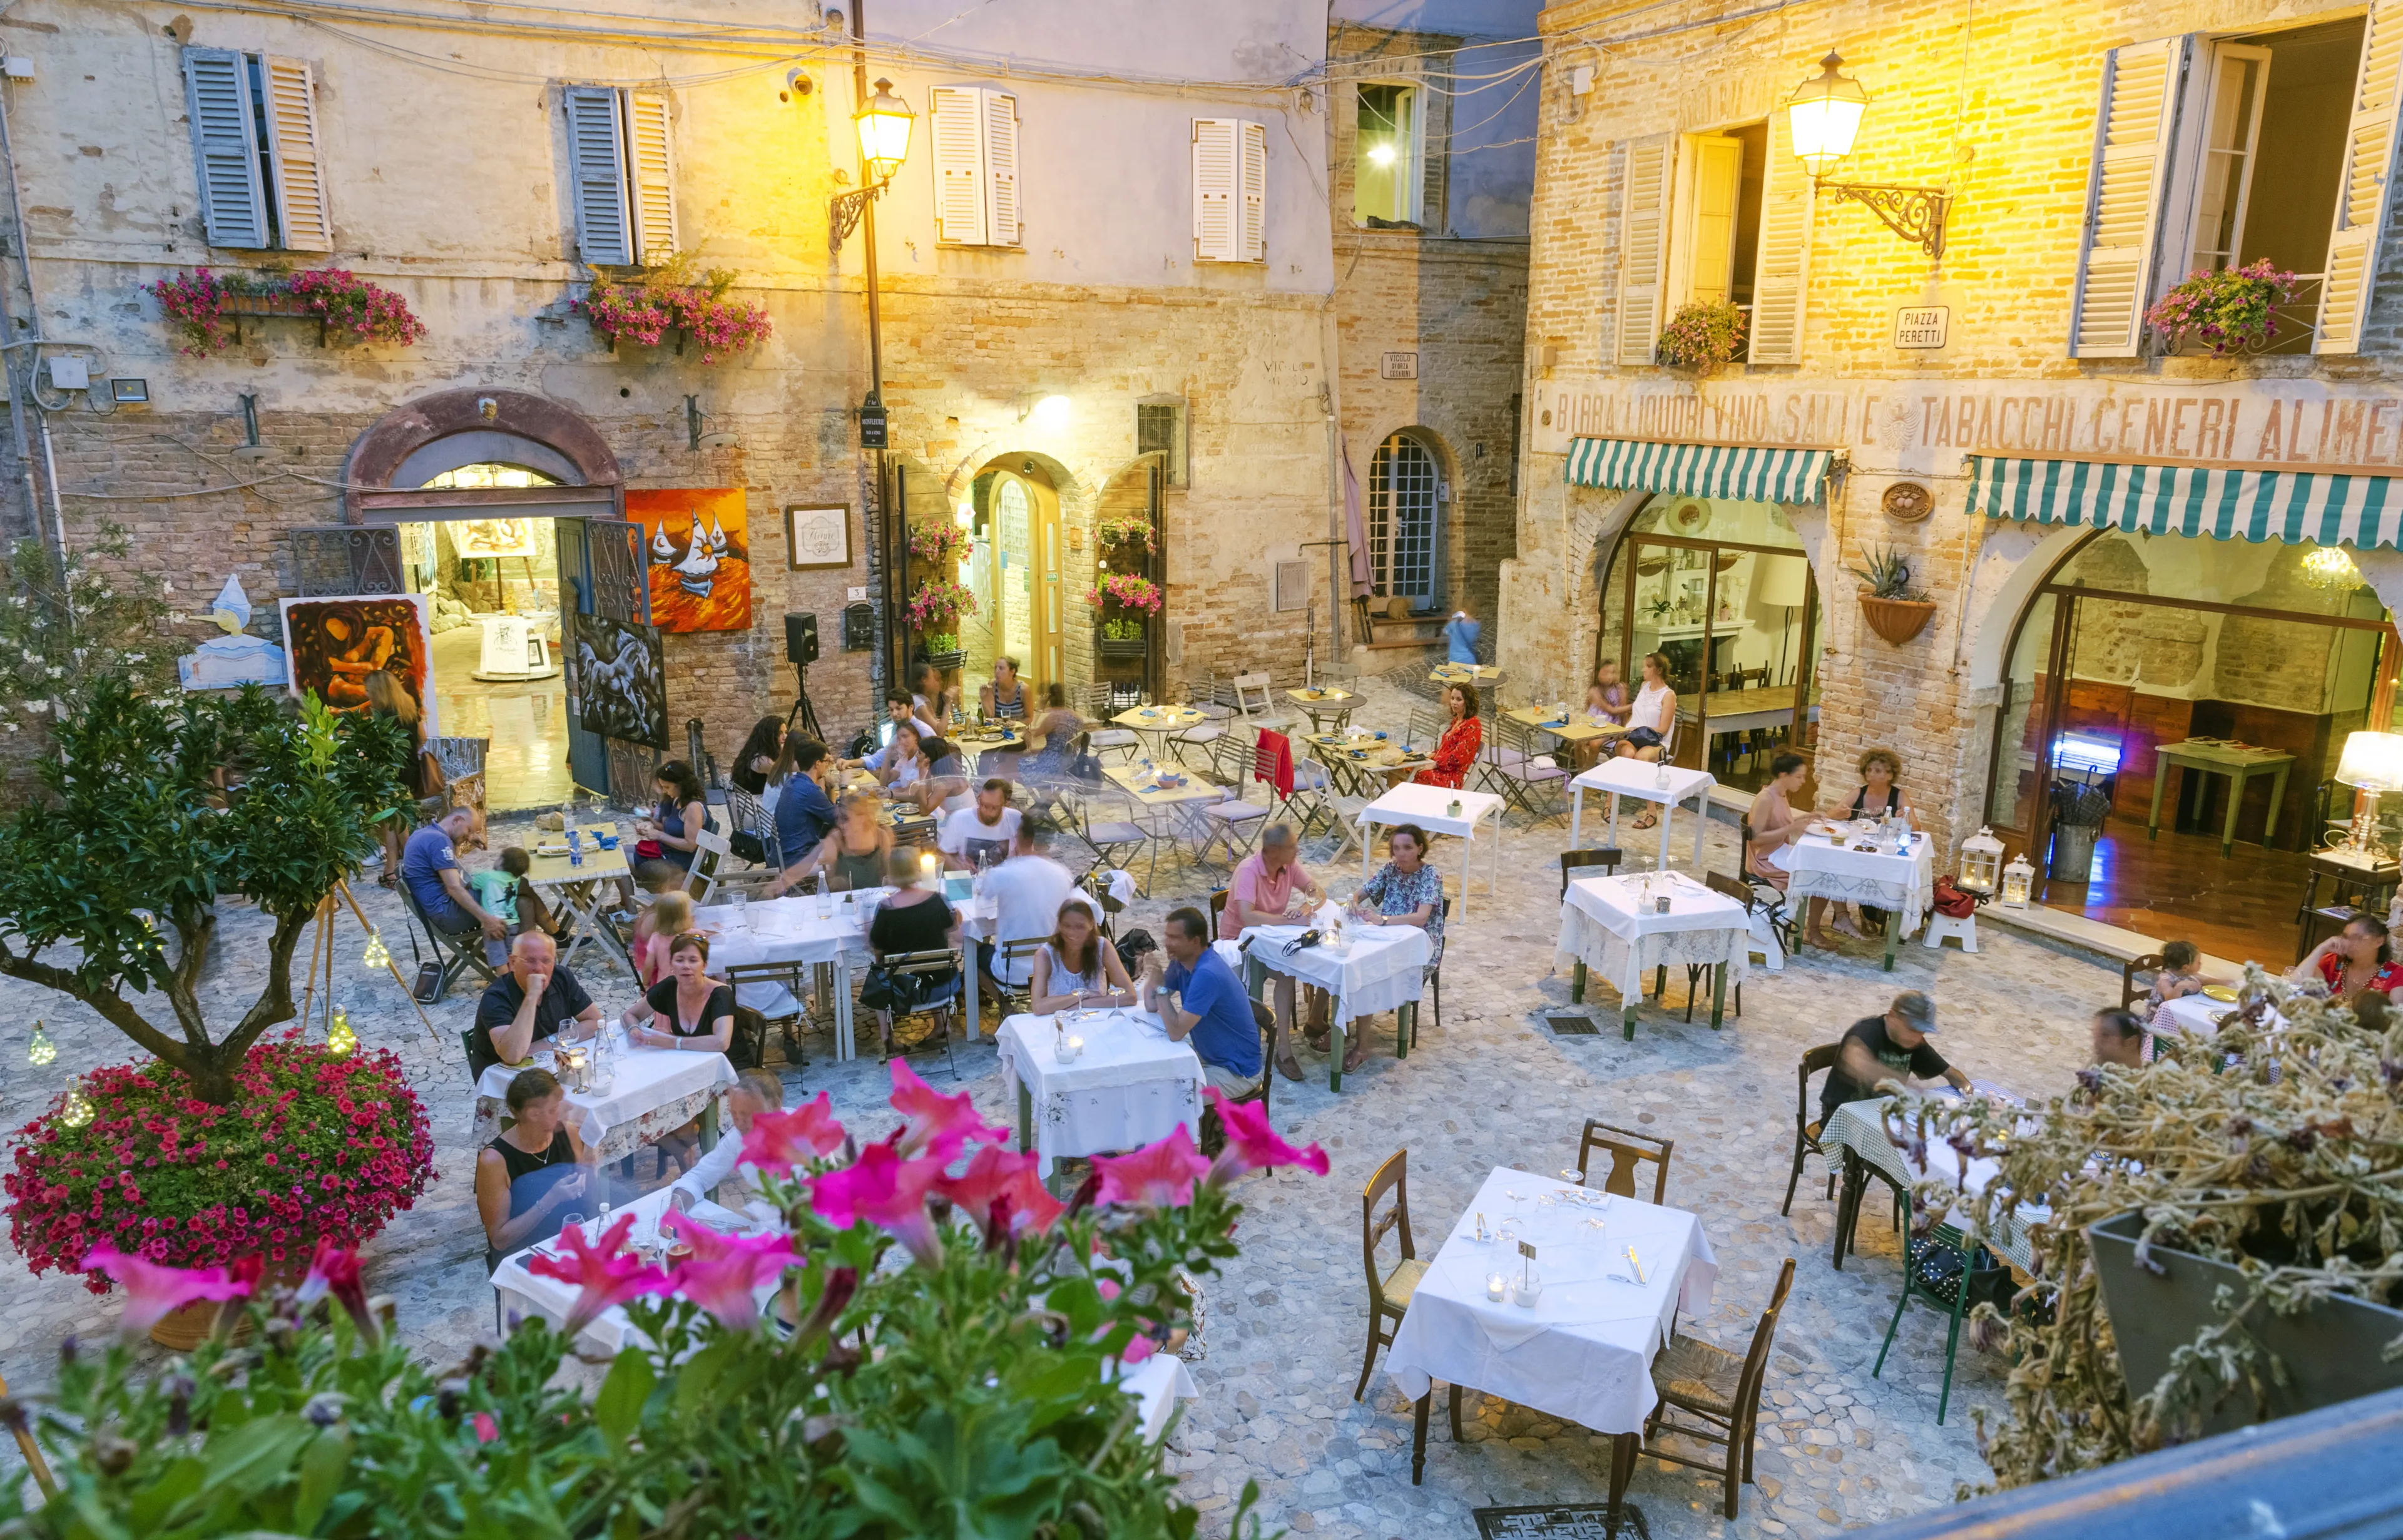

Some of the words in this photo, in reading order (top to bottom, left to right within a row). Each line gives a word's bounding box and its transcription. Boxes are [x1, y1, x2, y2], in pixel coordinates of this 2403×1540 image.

[1905, 313, 1937, 325] PIAZZA
[1899, 330, 1941, 342] PERETTI
[1556, 393, 1615, 435] BIRRA
[1625, 394, 1705, 438] LIQUORI
[1713, 394, 1768, 442] VINO
[1861, 395, 1882, 445] E
[1922, 396, 2076, 451] TABACCHI
[2093, 398, 2240, 459] GENERI
[2256, 399, 2403, 464] ALIME
[1895, 485, 1922, 494] OSTERIA
[1520, 1245, 1525, 1253] 5
